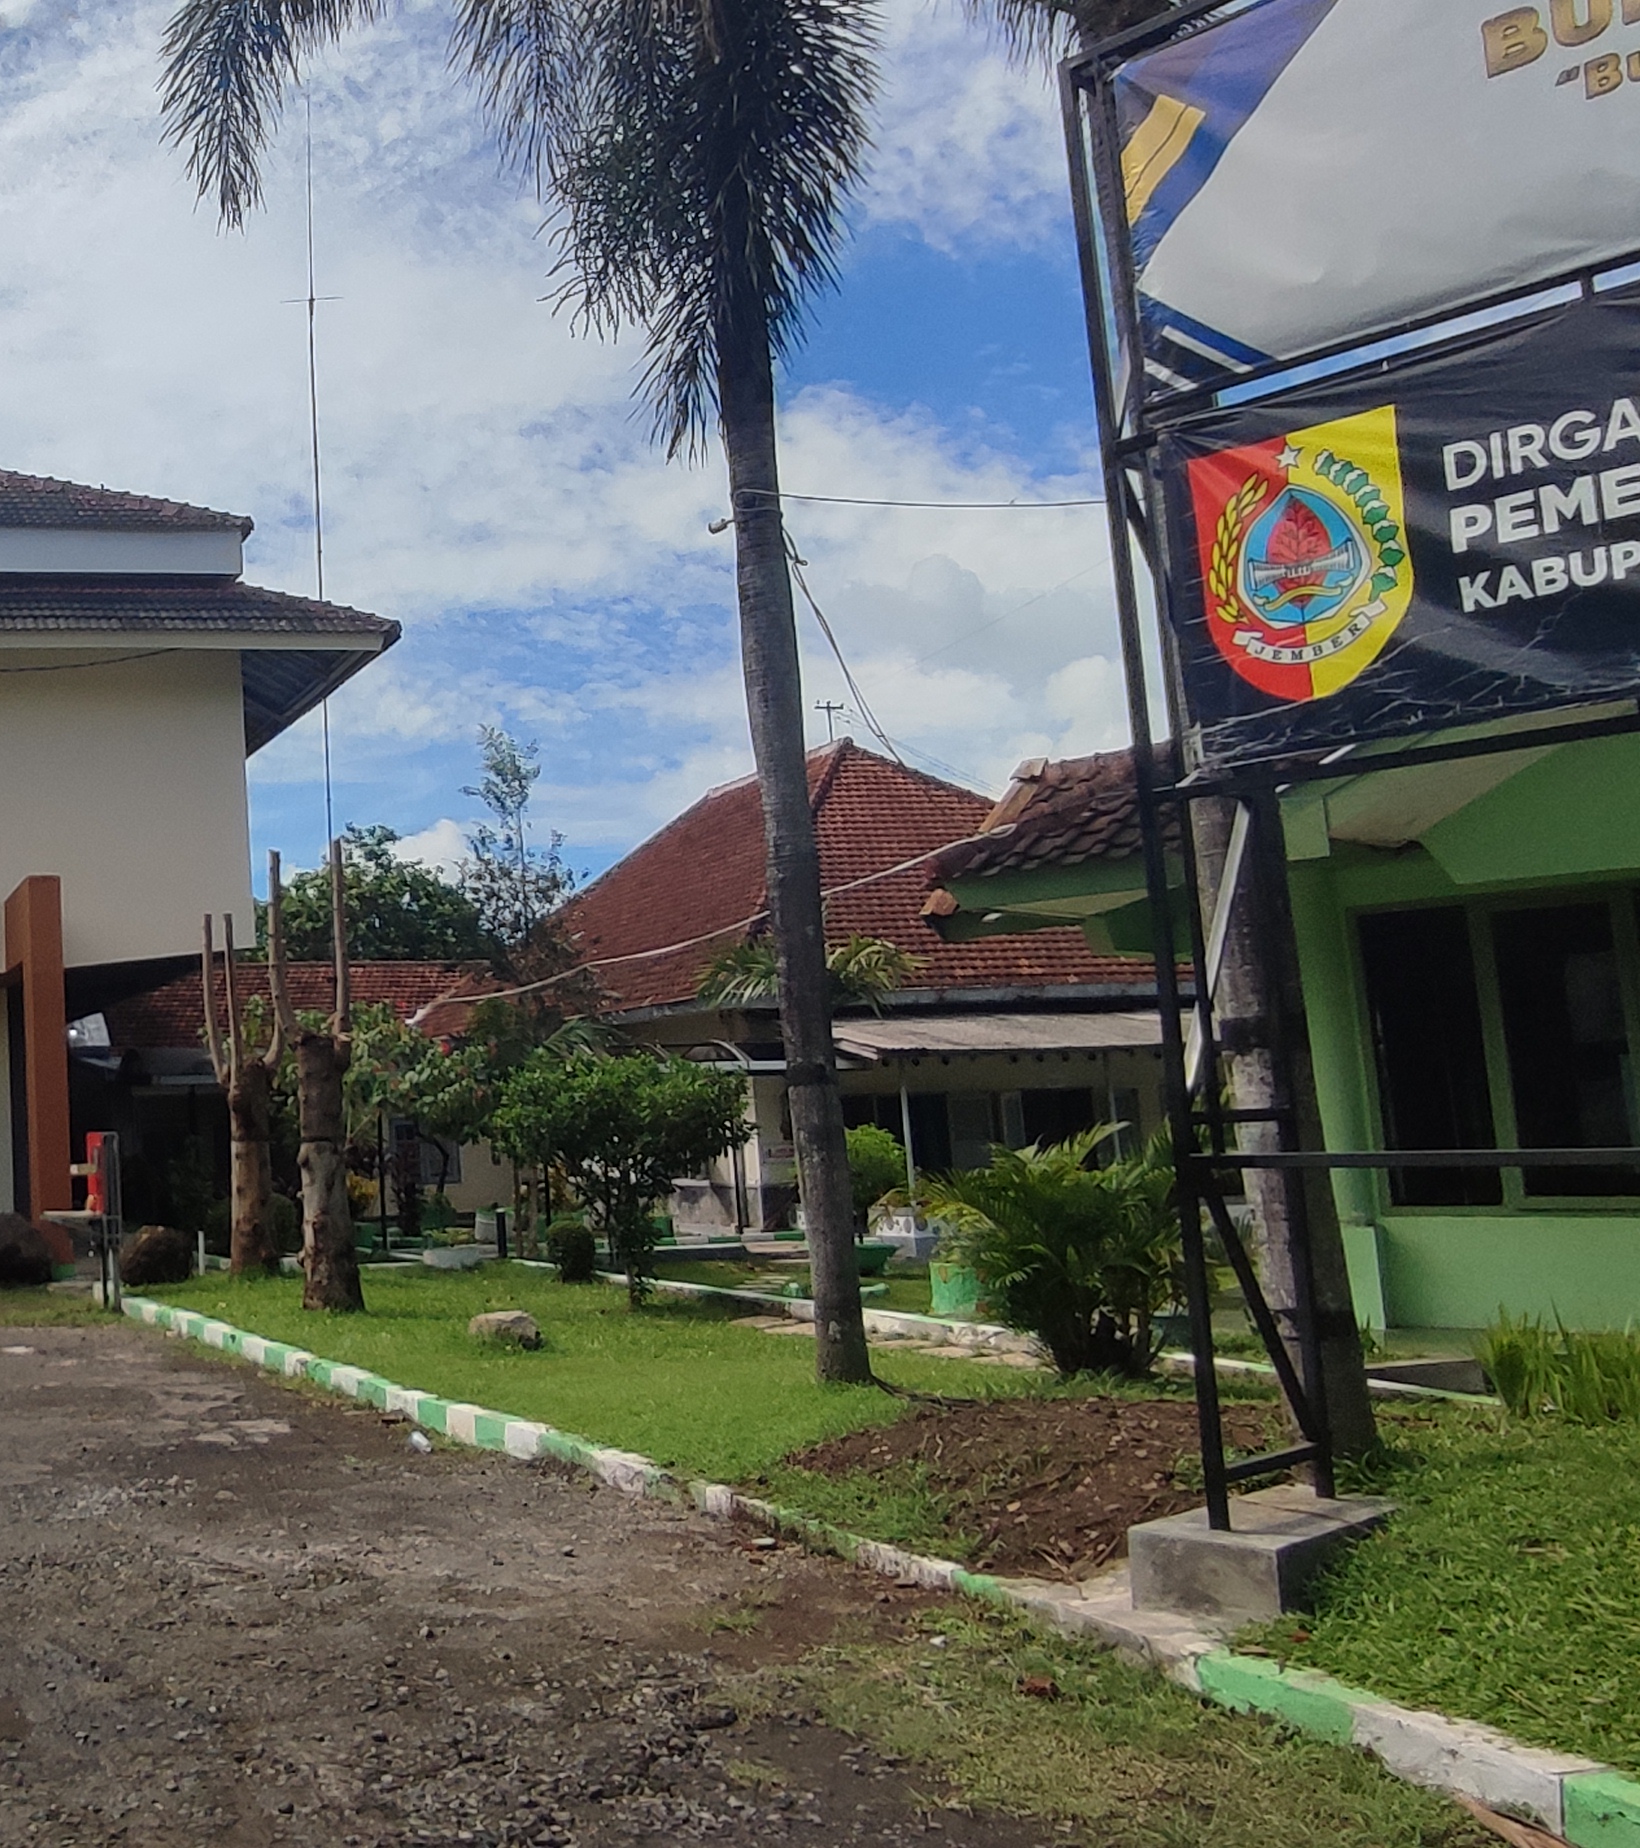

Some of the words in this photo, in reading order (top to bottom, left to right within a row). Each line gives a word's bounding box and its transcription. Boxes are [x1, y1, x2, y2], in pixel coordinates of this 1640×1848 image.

[1481, 0, 1640, 79] BU
[1442, 398, 1640, 491] DIRGA
[1450, 463, 1640, 553] PEME
[1458, 540, 1640, 613] KABUP
[1254, 622, 1364, 661] JEMBER
